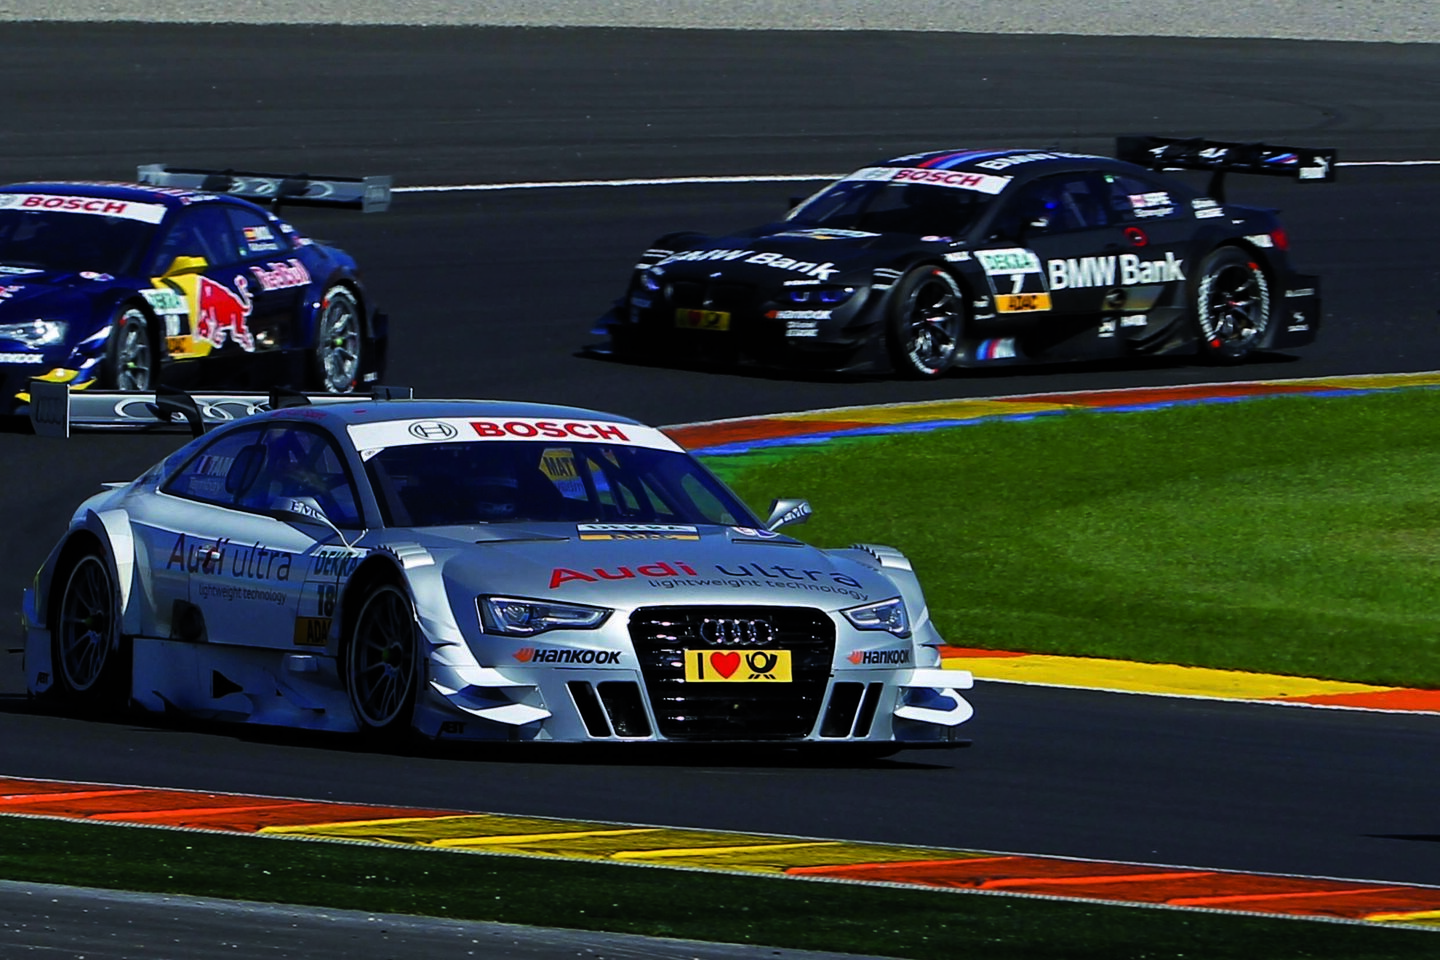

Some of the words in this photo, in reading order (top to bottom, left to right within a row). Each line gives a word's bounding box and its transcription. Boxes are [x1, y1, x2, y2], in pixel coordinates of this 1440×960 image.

[891, 169, 984, 187] BOSCH
[21, 196, 127, 214] BOSCH
[656, 249, 756, 266] BMW
[744, 252, 841, 281] Bank
[1047, 255, 1117, 291] BMW
[1119, 251, 1187, 286] Bank
[1010, 273, 1025, 294] 7
[469, 420, 631, 442] BOSCH
[166, 532, 230, 573] Audi
[232, 540, 293, 582] ultra
[548, 561, 698, 590] Audi
[714, 562, 864, 590] ultra
[198, 583, 242, 602] lightweight
[243, 584, 289, 605] technology
[648, 577, 761, 590] lightweight
[765, 579, 870, 602] technology
